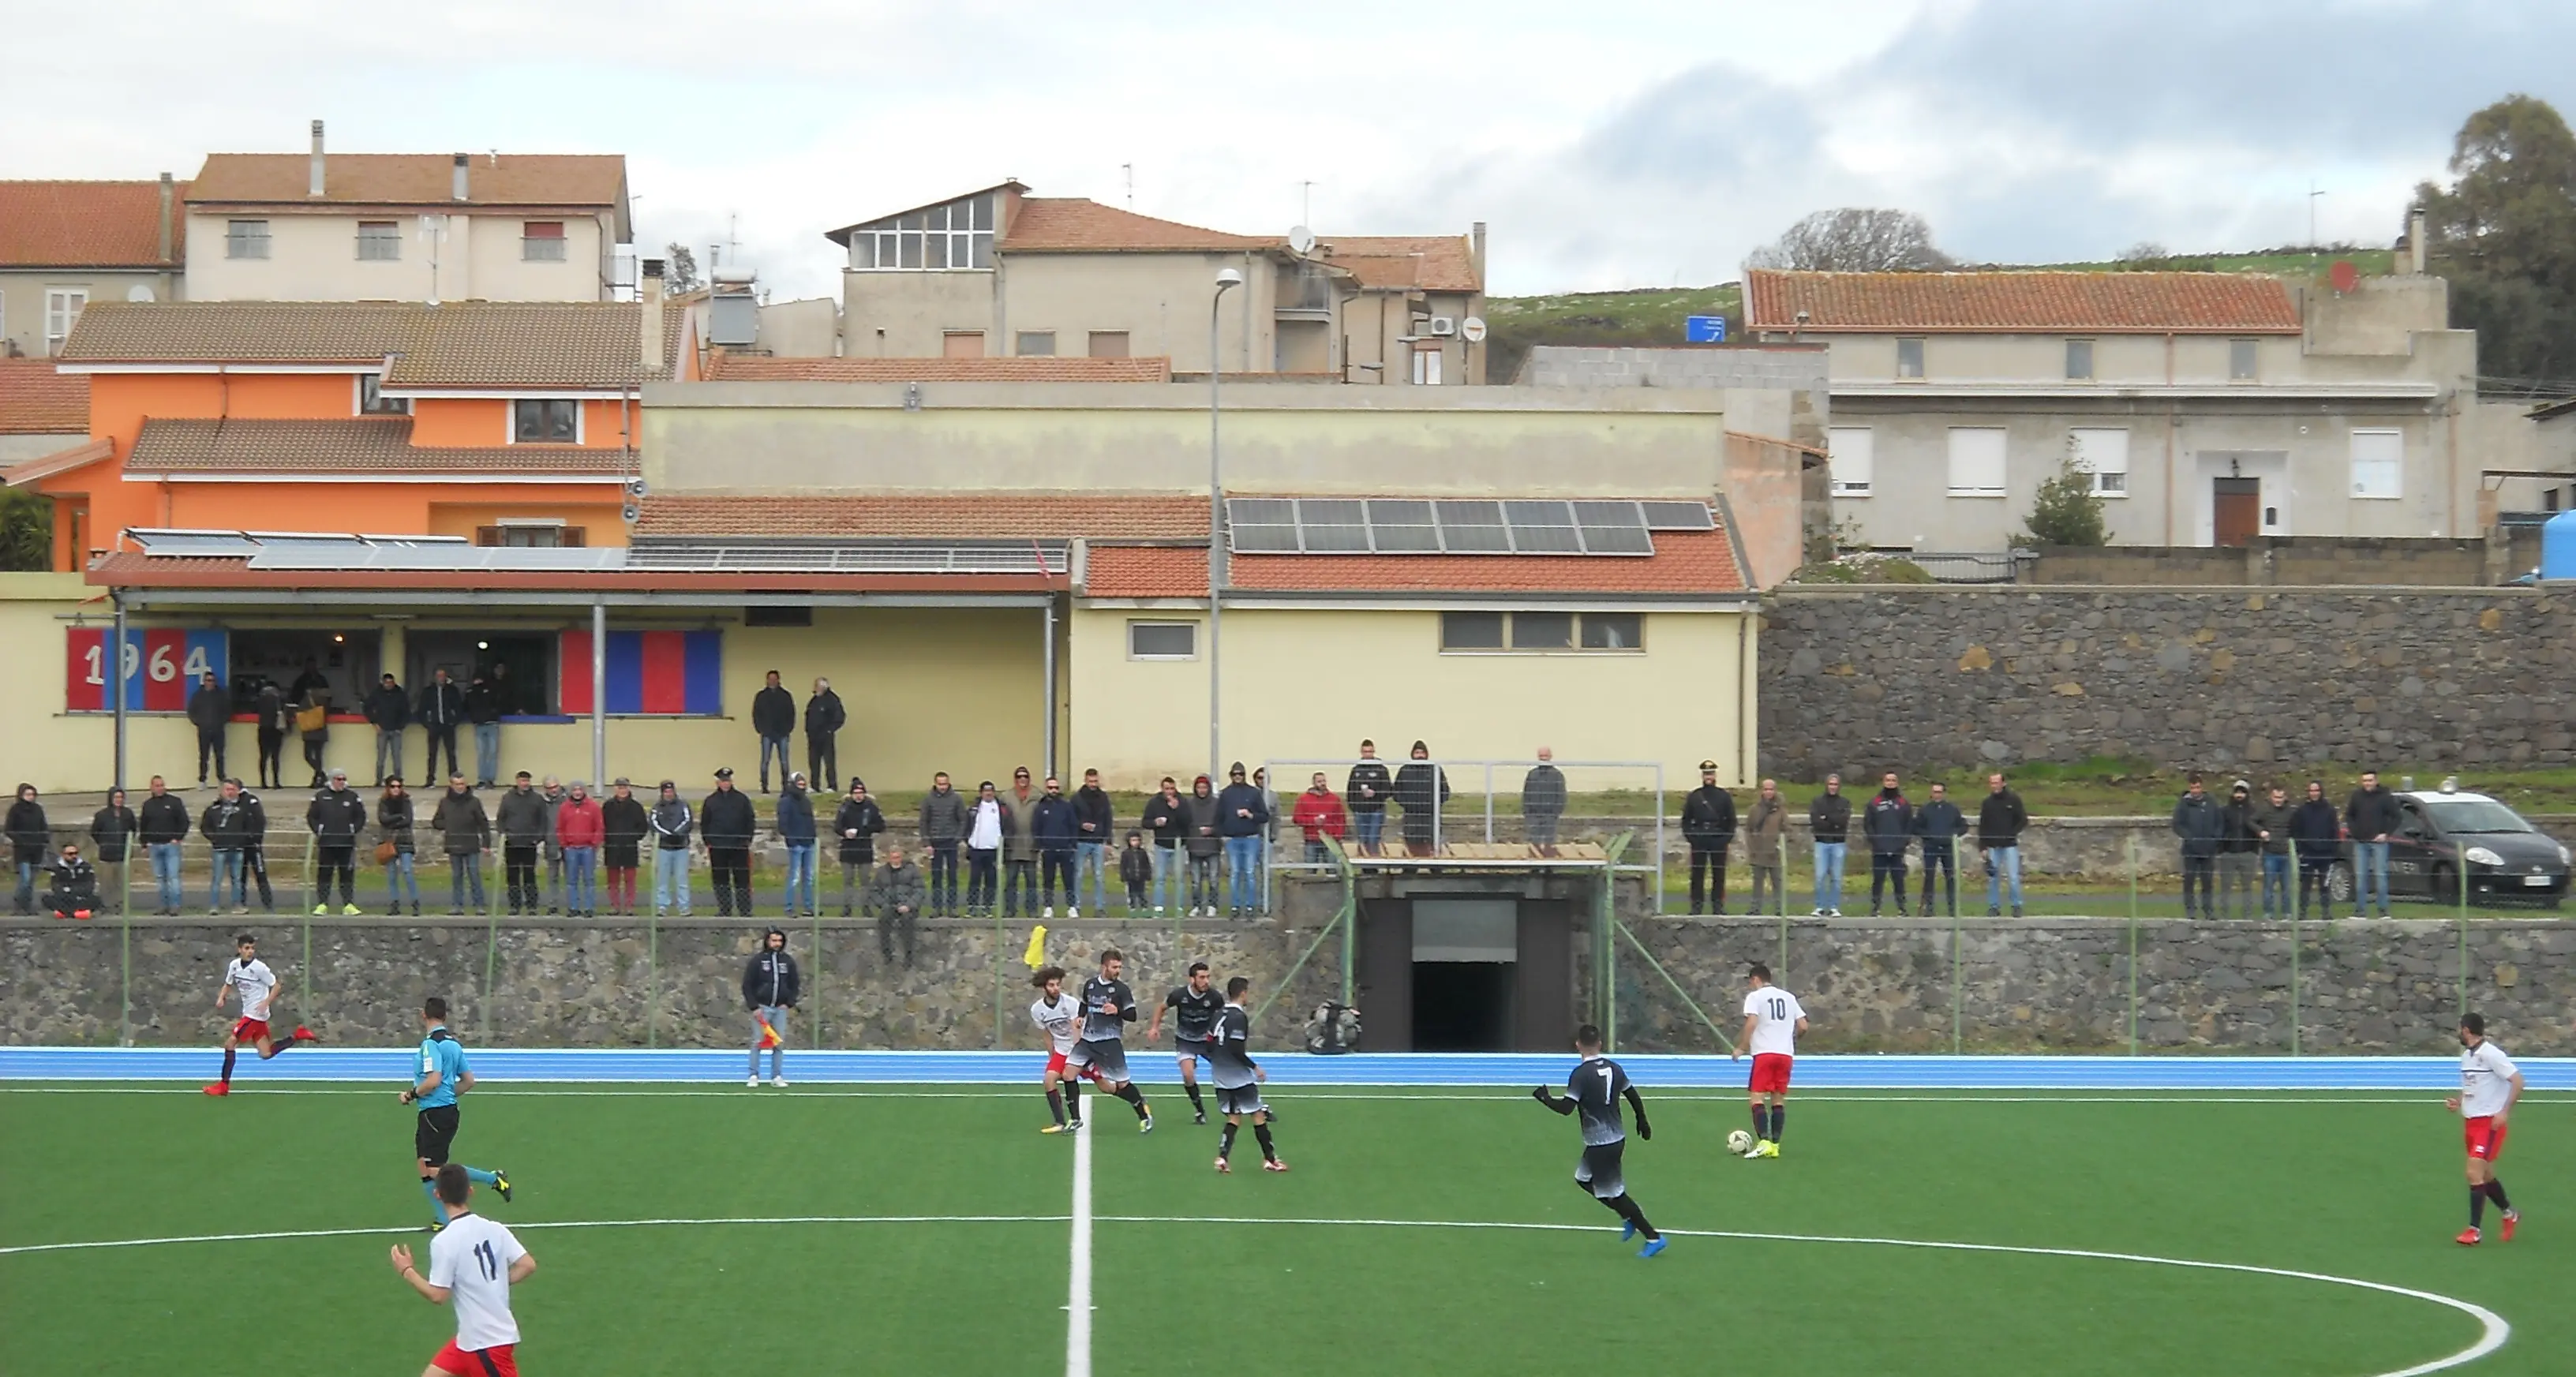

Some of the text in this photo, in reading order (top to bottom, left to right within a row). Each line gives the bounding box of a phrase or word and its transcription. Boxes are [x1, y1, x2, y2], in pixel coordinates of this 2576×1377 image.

[1767, 997, 1786, 1021] 10
[1213, 1016, 1226, 1046] 4
[1597, 1066, 1613, 1105] 7
[474, 1239, 496, 1283] 11
